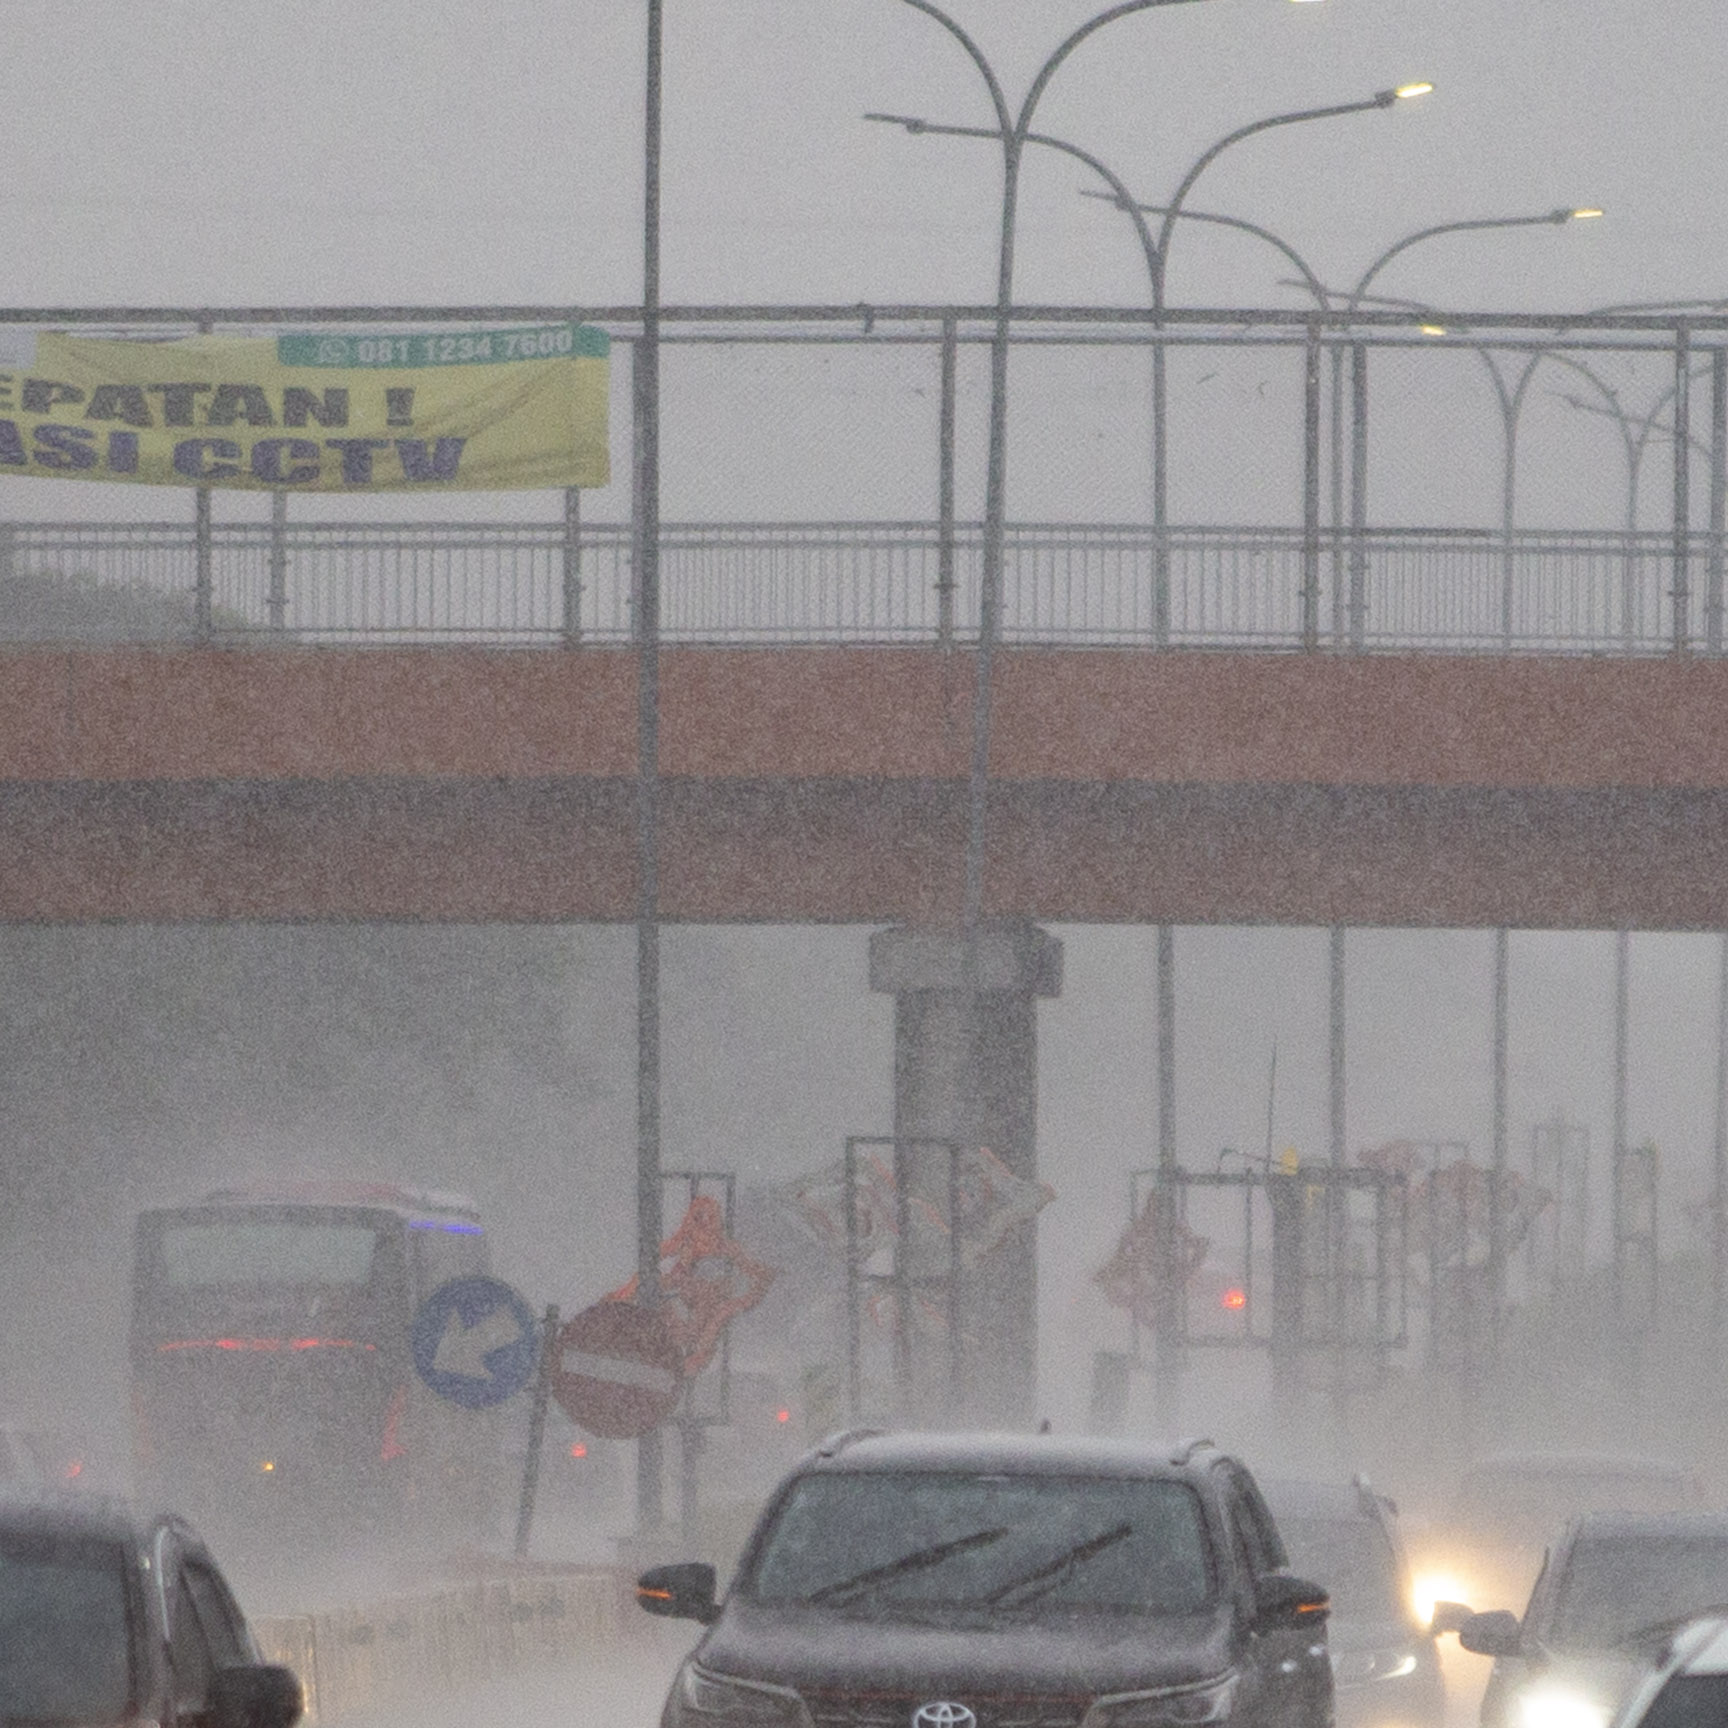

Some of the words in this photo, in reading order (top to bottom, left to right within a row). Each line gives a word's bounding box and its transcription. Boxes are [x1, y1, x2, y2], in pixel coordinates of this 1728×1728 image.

[358, 340, 409, 362] 081
[425, 337, 492, 361] 1234
[503, 331, 573, 356] 7600
[386, 387, 414, 426] !
[174, 437, 466, 484] CCTV
